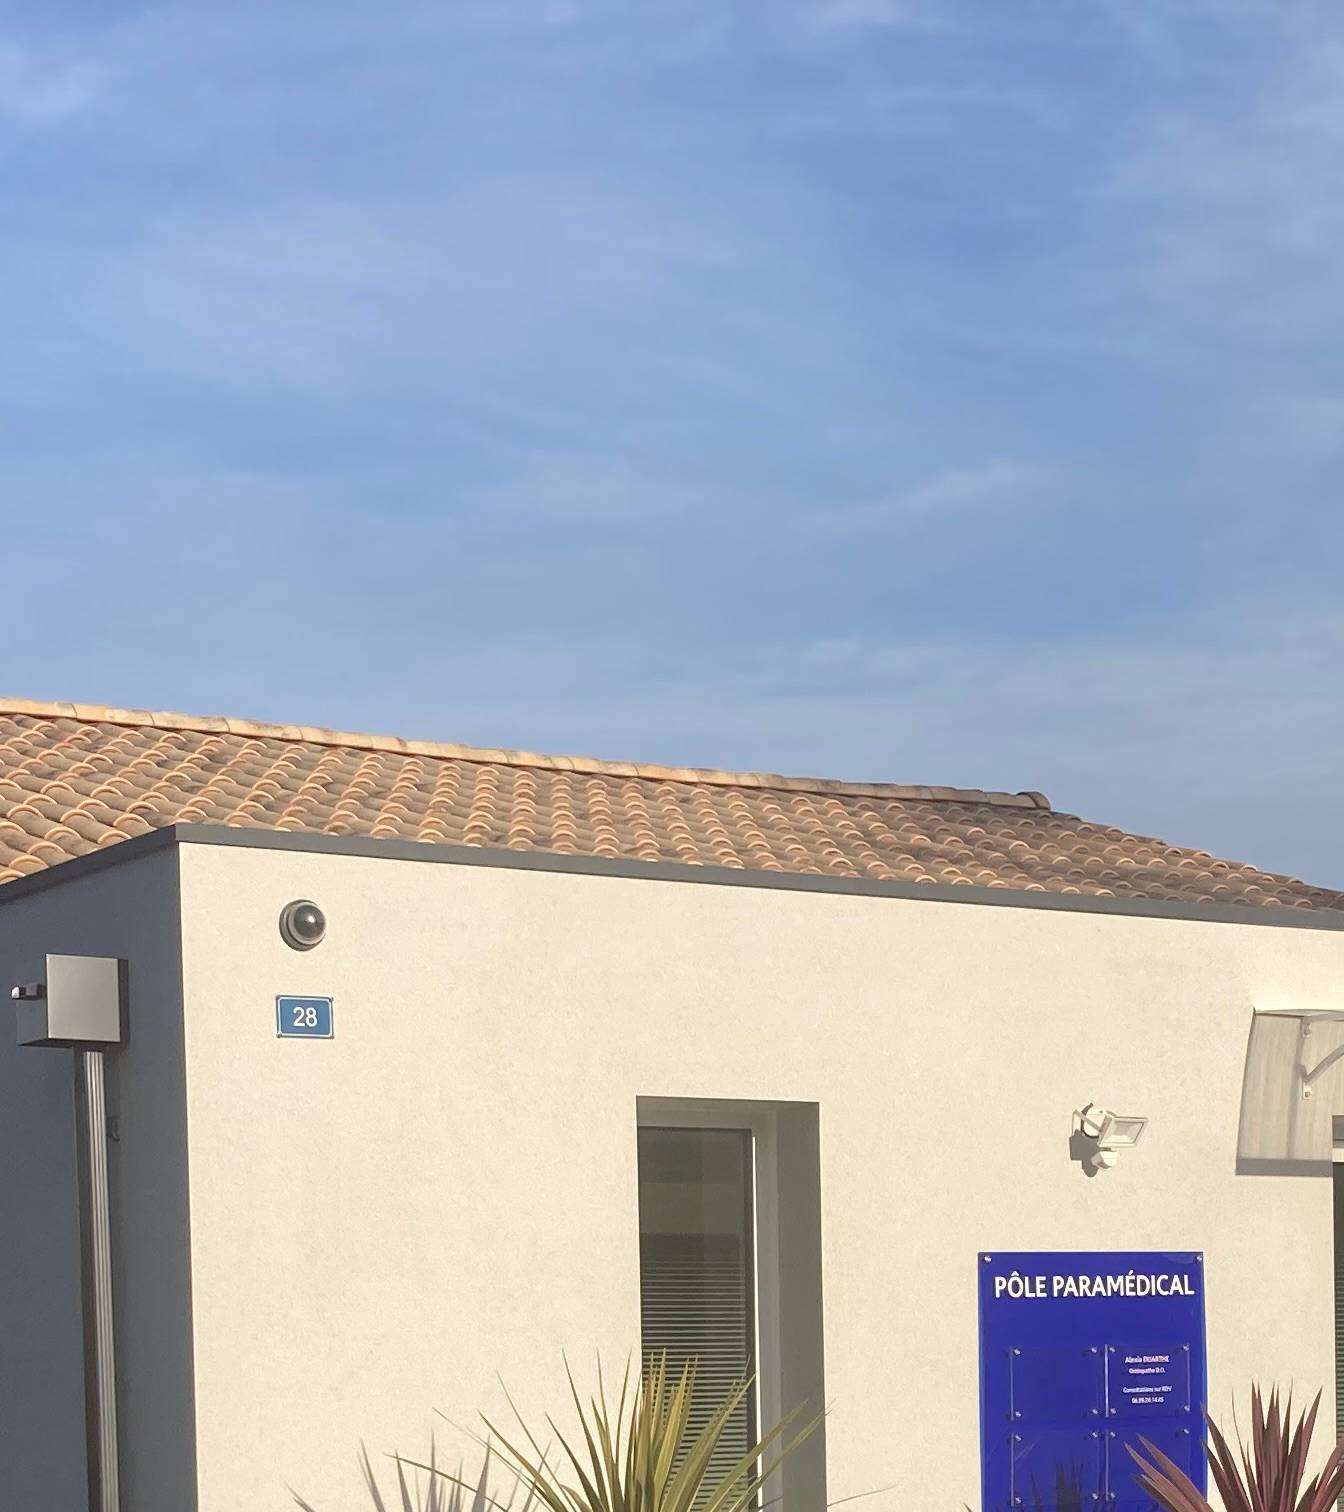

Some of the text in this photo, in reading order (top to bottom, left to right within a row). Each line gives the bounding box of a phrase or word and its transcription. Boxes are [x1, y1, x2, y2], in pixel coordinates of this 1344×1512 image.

[293, 1006, 318, 1027] 28
[994, 1269, 1195, 1298] PÔLE PARAMÉDICAL
